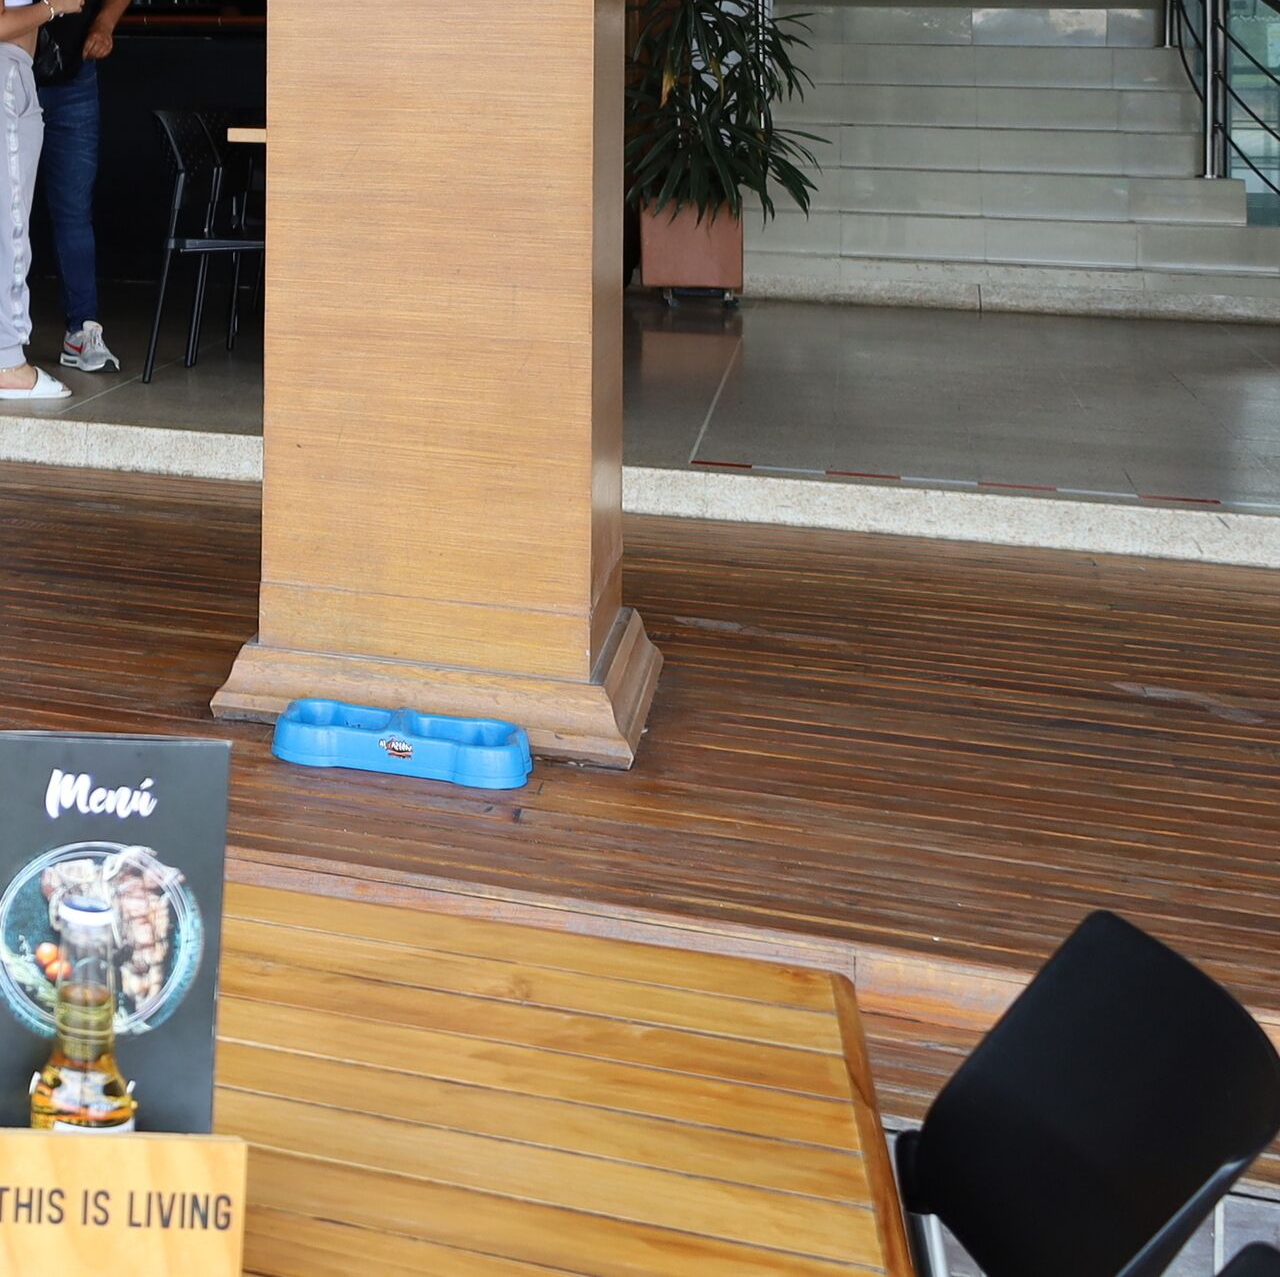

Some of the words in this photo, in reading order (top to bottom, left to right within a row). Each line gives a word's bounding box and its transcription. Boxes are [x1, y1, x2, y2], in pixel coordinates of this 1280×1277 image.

[45, 767, 160, 820] Menú
[81, 1189, 111, 1227] IS
[127, 1190, 234, 1231] LIVING
